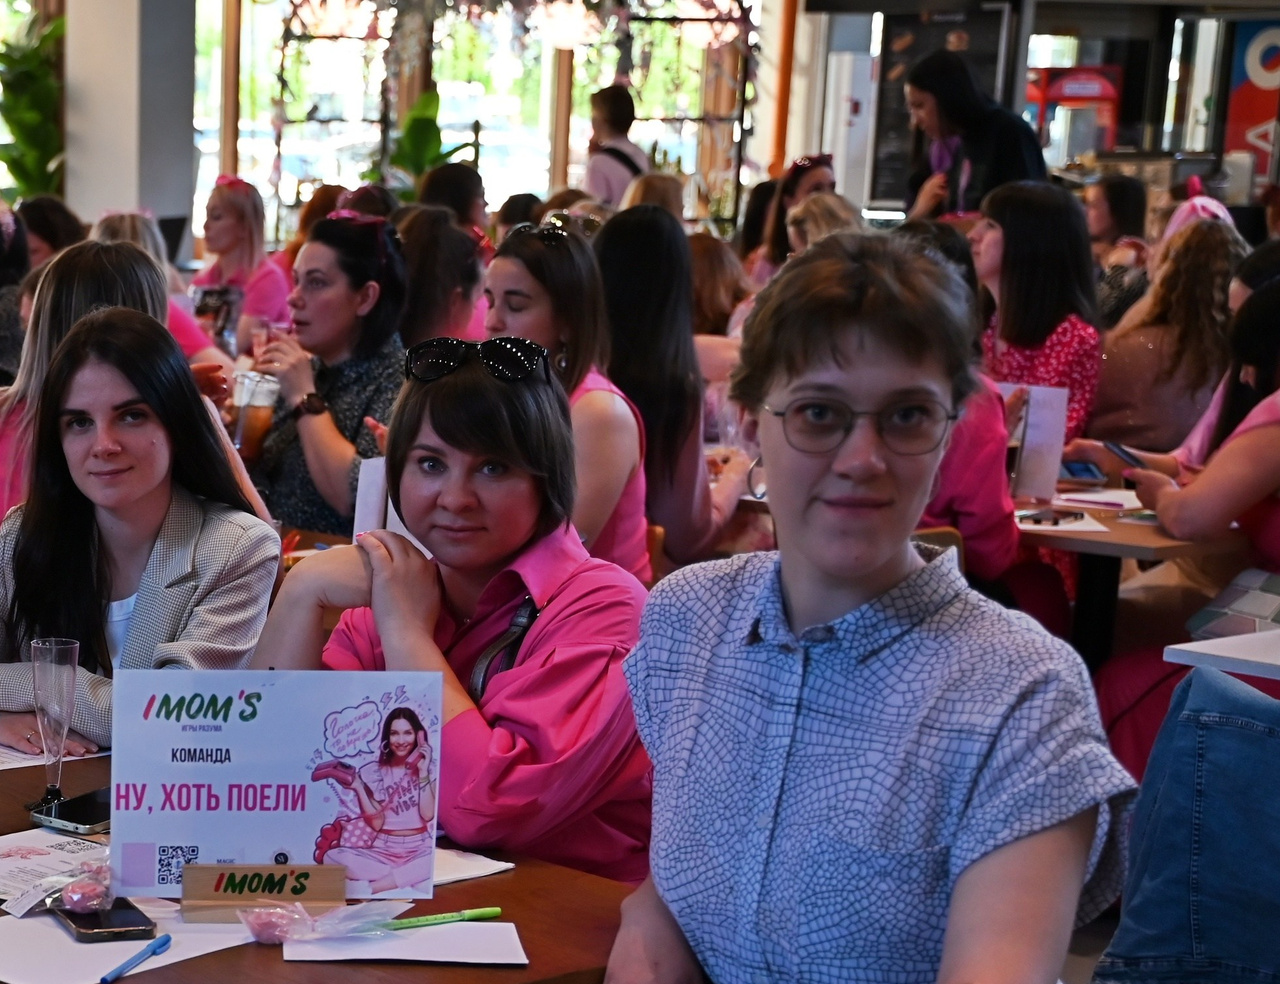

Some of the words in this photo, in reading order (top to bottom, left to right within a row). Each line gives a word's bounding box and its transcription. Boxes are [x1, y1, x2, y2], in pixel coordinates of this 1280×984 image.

[181, 724, 197, 732] ИГРЫ
[198, 724, 222, 732] РАЗУМА
[171, 747, 231, 764] КОМАНДА
[115, 782, 153, 815] НУ,
[160, 782, 223, 812] ХОТЬ
[227, 782, 307, 812] ПОЕЛИ
[390, 795, 418, 816] VIBE
